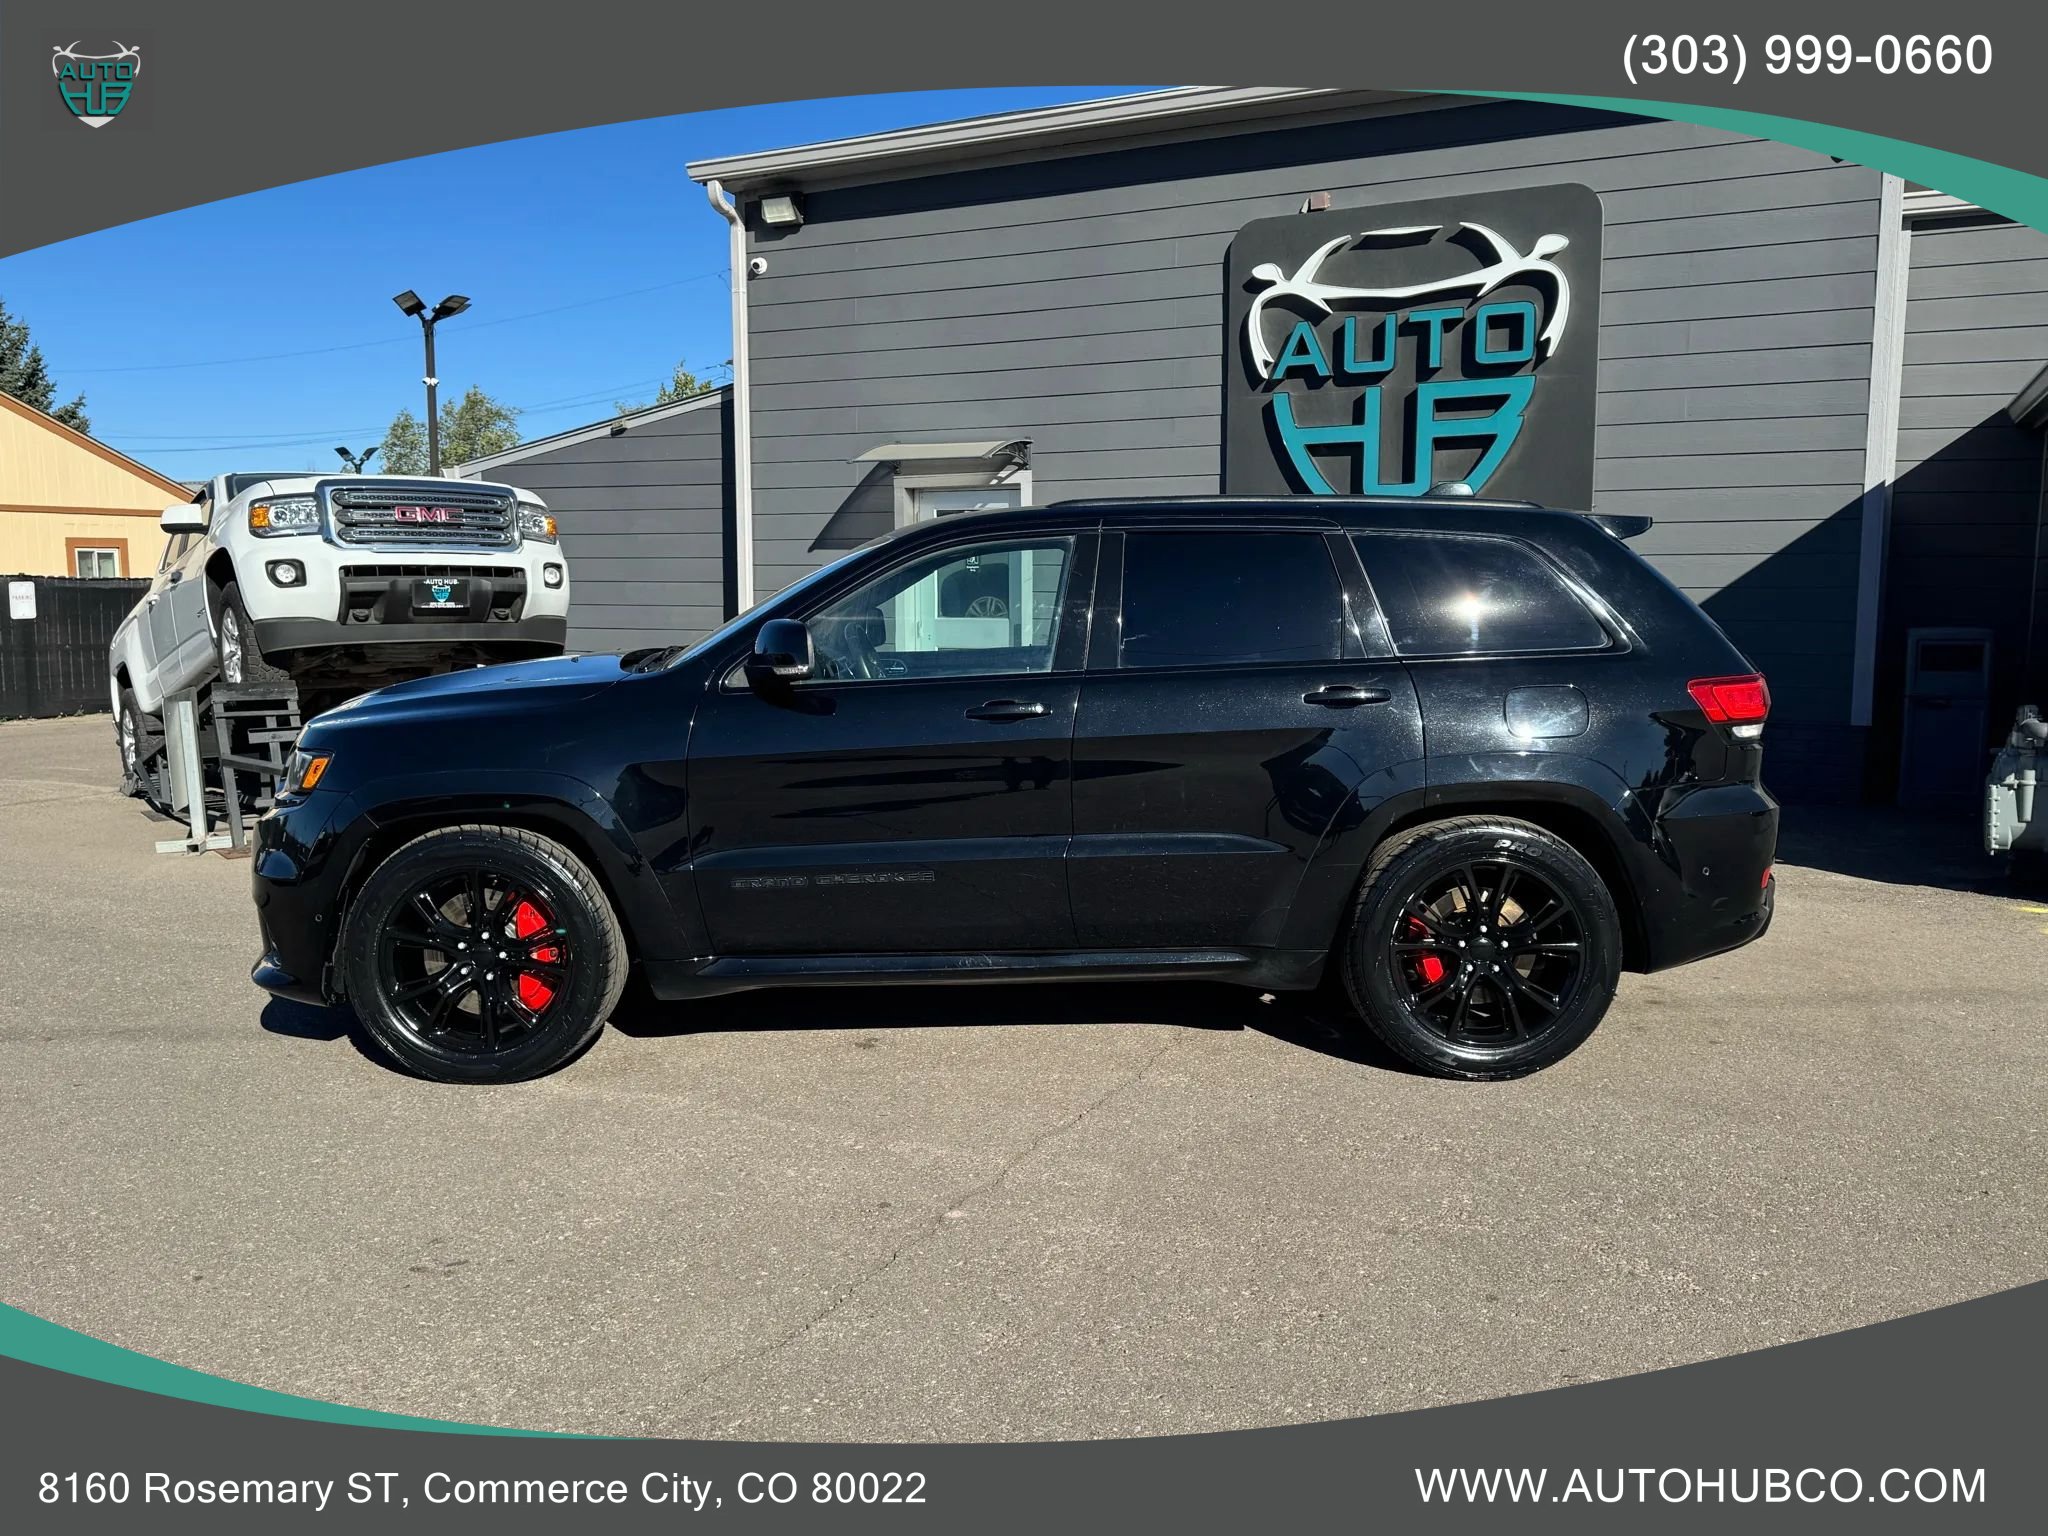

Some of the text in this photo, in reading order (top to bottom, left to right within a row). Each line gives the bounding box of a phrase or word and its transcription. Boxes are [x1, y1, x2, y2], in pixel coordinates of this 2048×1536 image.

[1271, 300, 1537, 380] AUTO
[394, 505, 466, 523] GMC
[730, 870, 936, 888] GRAND CHEROKEE
